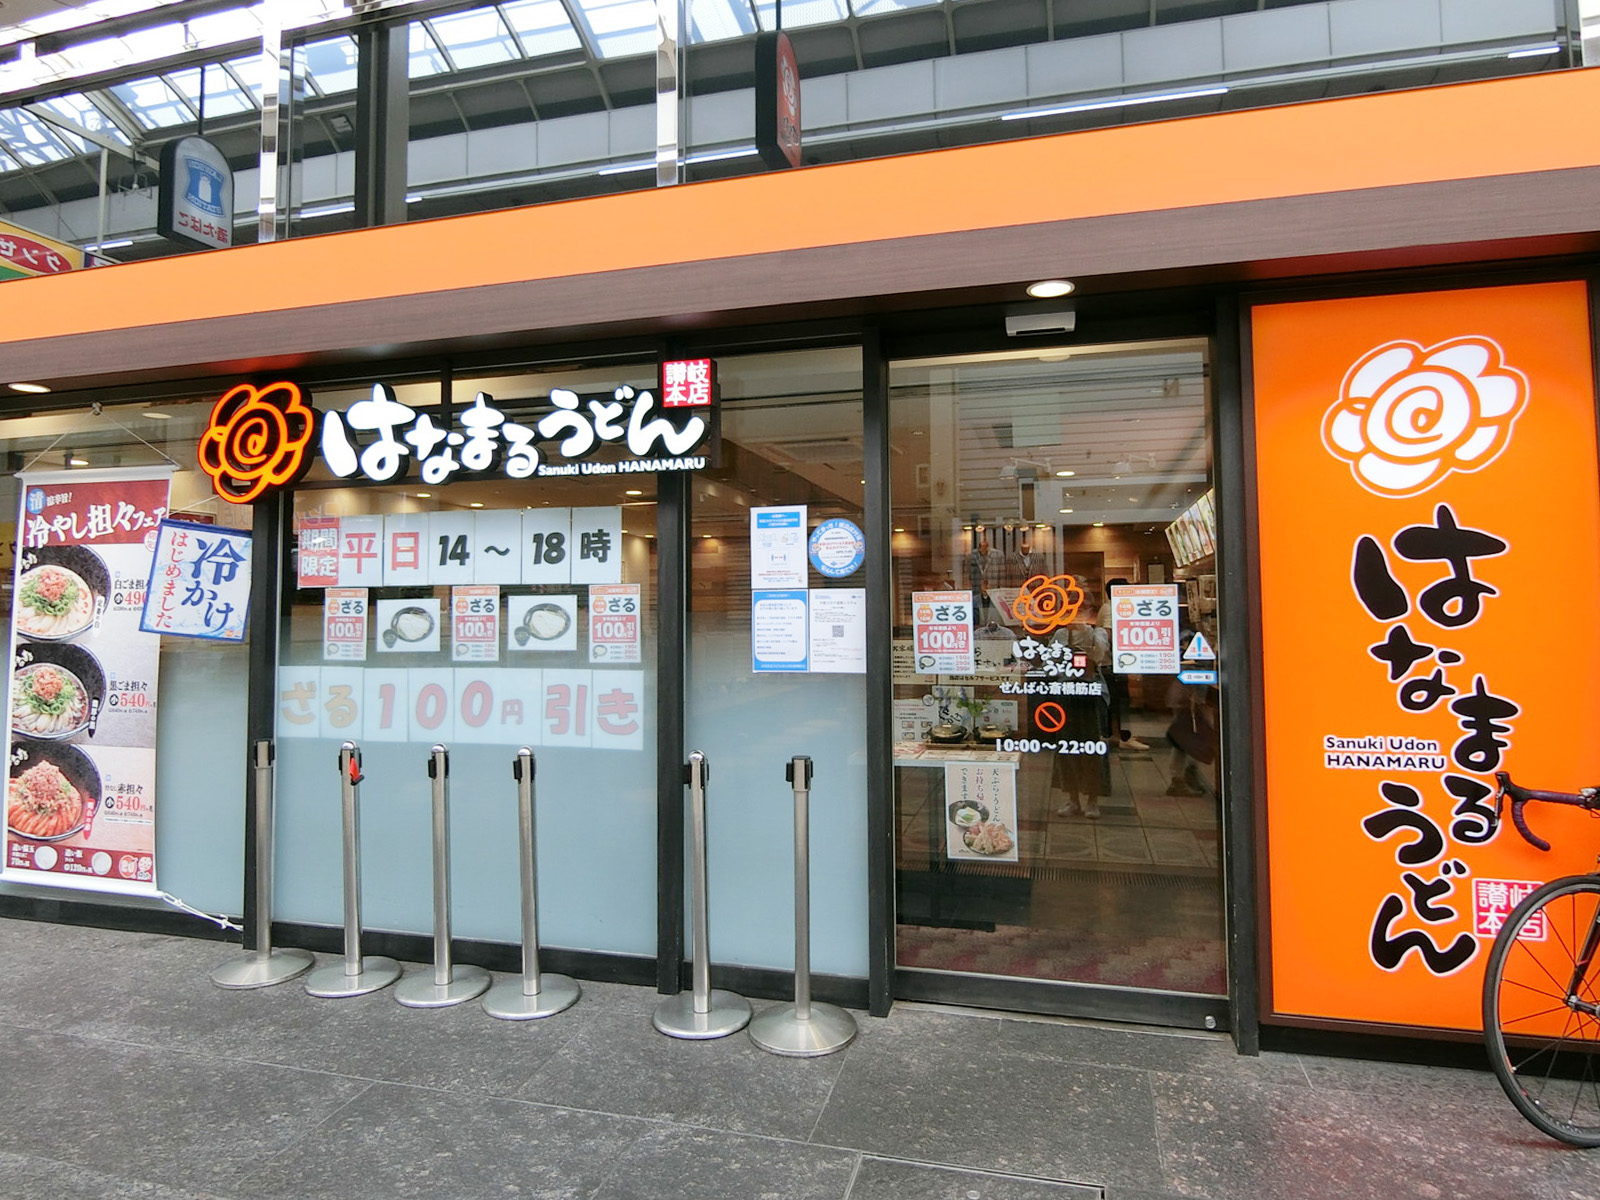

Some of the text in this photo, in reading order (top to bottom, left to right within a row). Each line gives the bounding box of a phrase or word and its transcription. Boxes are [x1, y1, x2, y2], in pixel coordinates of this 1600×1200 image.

[666, 360, 709, 385] 讃岐
[665, 382, 709, 406] 本店
[321, 382, 706, 485] はなまるうどん
[538, 457, 706, 476] Sanuki Udon HANAMARU
[300, 556, 338, 577] 限定
[155, 531, 189, 628] はじめました
[181, 538, 247, 634] 冷かけ
[470, 598, 495, 613] ざる
[608, 597, 636, 613] ざる
[935, 605, 967, 621] ざる
[1137, 599, 1172, 616] ざる
[1012, 636, 1073, 661] はなまる
[1043, 660, 1085, 677] うどん
[1326, 737, 1438, 751] Sanuki Udon
[1351, 503, 1520, 974] はなまるうどん
[1327, 755, 1445, 769] HANAMARU
